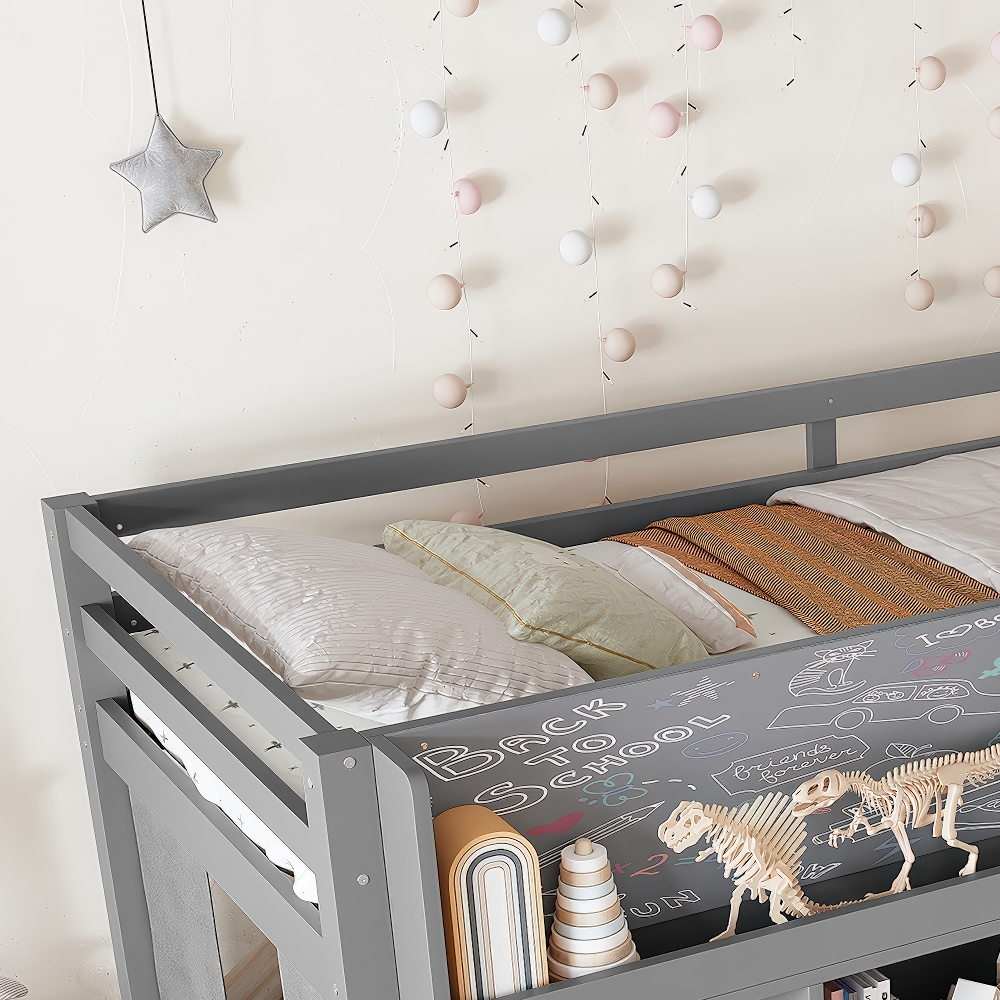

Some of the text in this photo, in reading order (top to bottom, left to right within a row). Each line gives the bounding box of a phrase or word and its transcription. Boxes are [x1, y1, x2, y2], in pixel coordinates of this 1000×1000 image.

[914, 634, 933, 648] I
[412, 697, 627, 782] BACK
[473, 714, 731, 816] SCHOOL
[523, 733, 617, 767] TO
